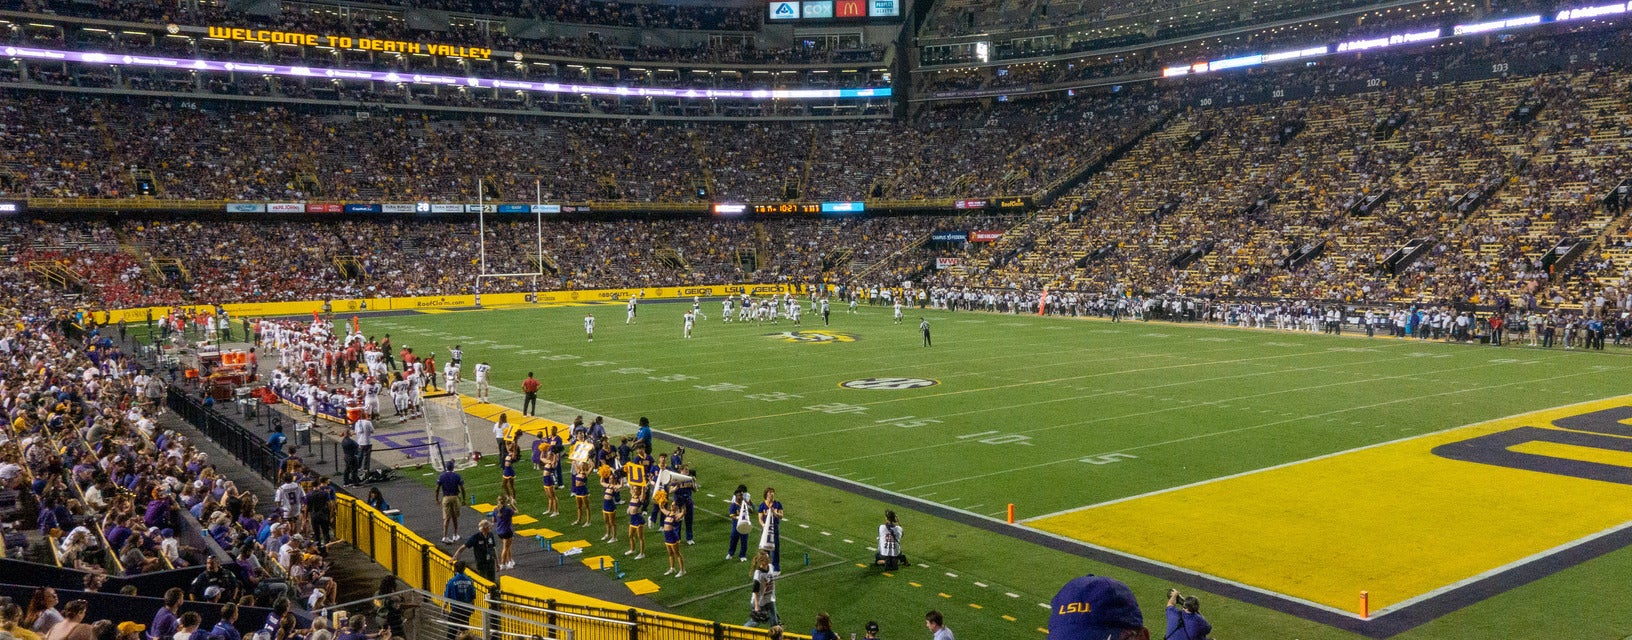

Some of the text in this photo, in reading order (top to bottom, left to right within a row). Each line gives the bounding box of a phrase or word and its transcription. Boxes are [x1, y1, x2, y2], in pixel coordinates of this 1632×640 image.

[804, 4, 832, 15] COX
[209, 26, 492, 59] WELCOME TO DEATH VALLEY
[1492, 63, 1509, 73] 103
[1367, 78, 1381, 88] 102
[1272, 89, 1285, 98] 101
[1200, 98, 1213, 107] 100
[874, 415, 944, 428] 15
[955, 430, 1033, 446] 10
[1078, 452, 1139, 465] 5
[629, 465, 643, 483] U
[1059, 602, 1091, 615] LSU
